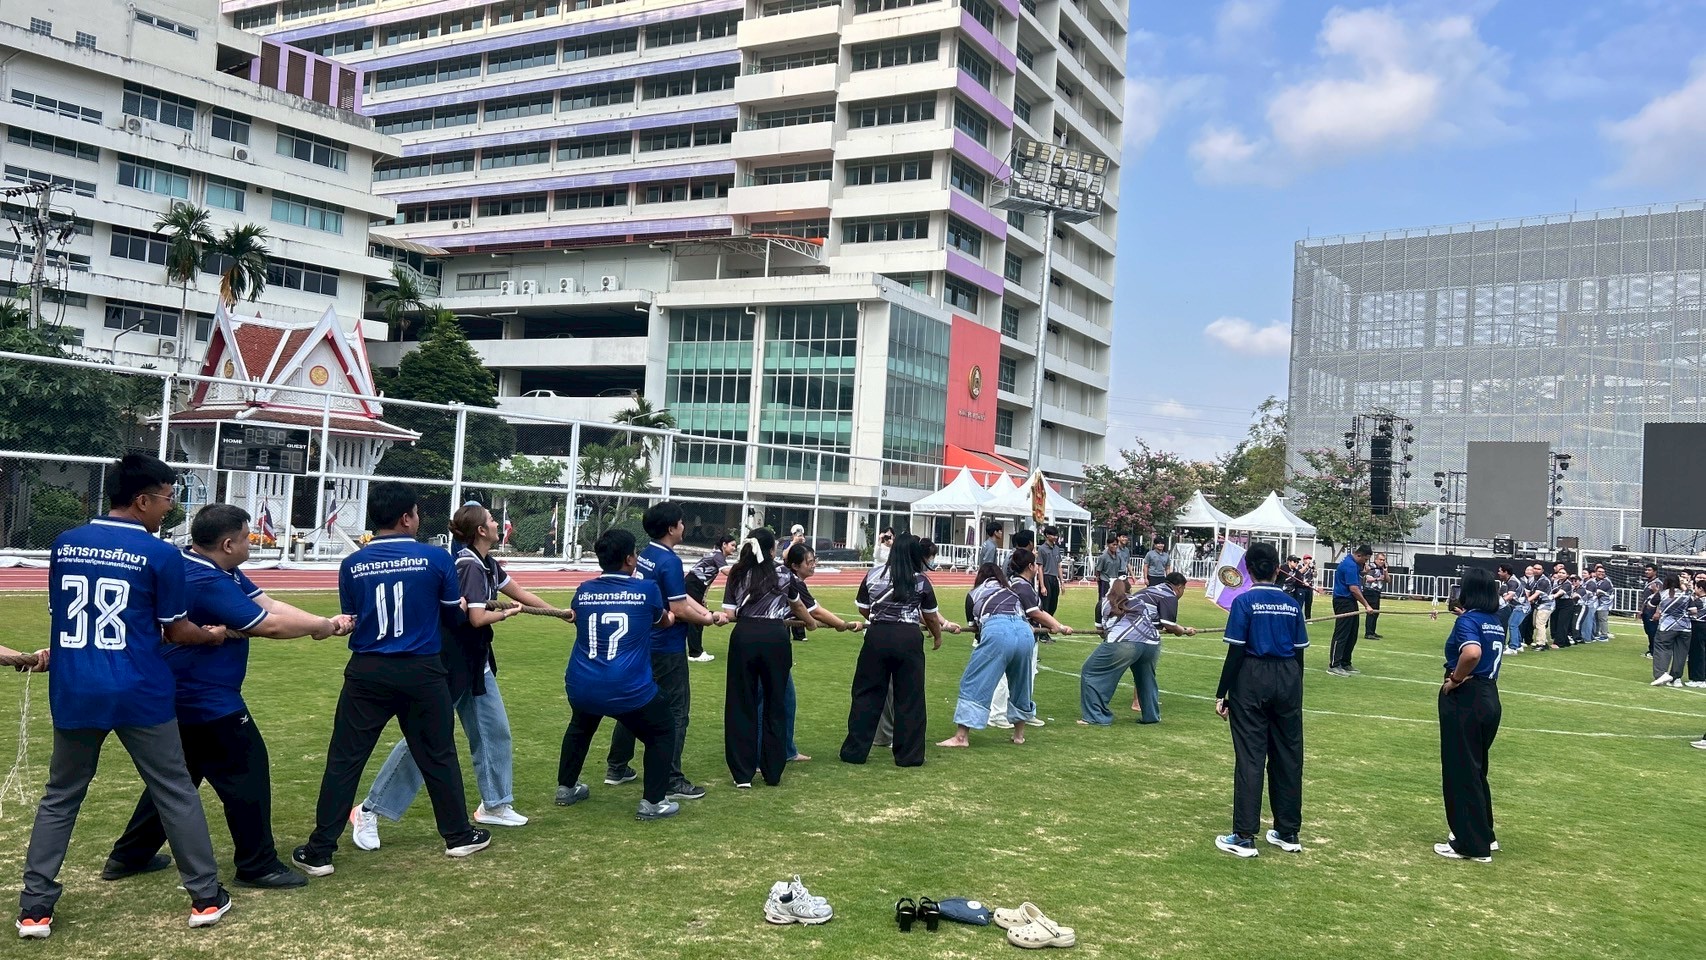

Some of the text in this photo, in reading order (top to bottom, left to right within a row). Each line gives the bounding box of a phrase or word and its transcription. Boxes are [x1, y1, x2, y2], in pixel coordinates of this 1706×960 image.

[222, 437, 243, 445] HOME
[57, 544, 147, 566] บริหารการศึกษา
[350, 556, 429, 574] บริหารการศึกษา
[375, 580, 404, 641] 11
[578, 590, 647, 601] บริหารการศึกษา
[60, 574, 131, 650] 38
[588, 612, 629, 661] 17
[1488, 640, 1503, 680] 7
